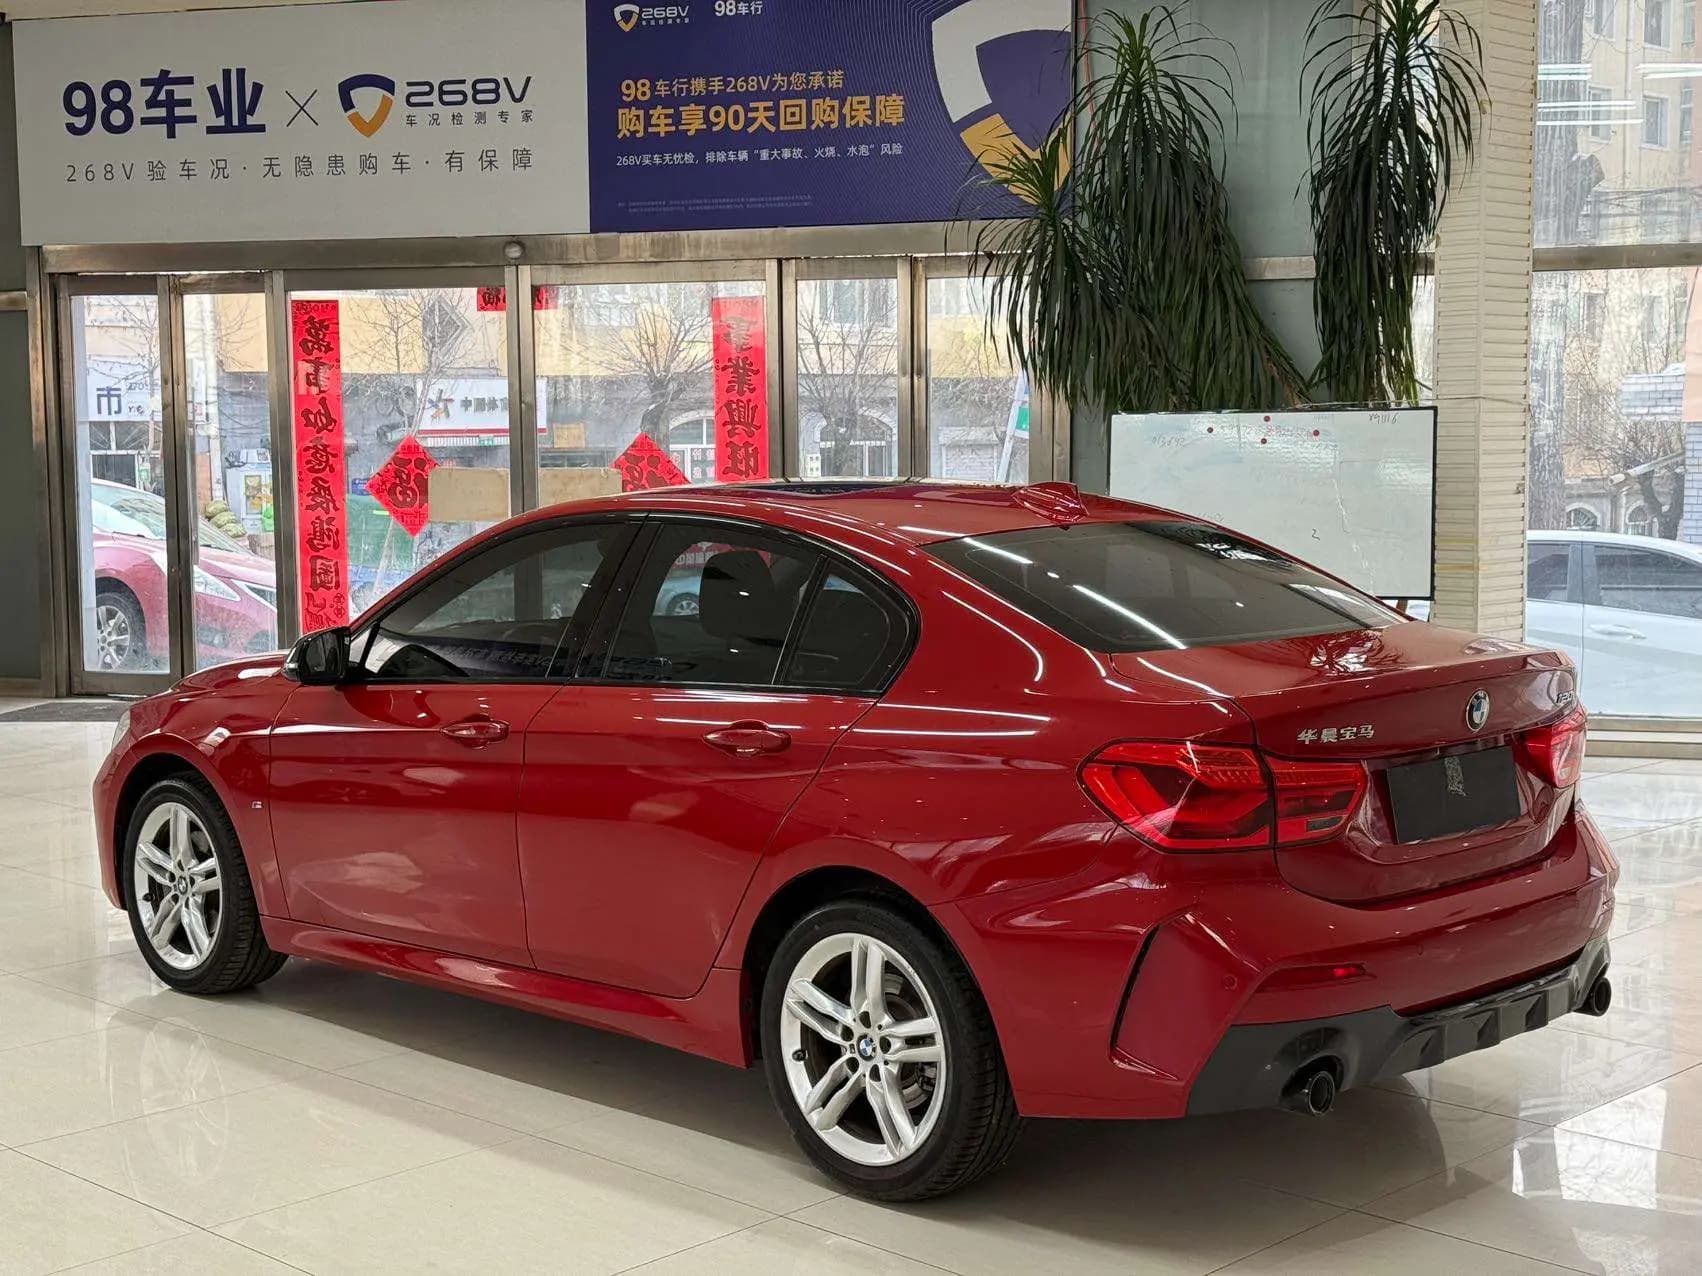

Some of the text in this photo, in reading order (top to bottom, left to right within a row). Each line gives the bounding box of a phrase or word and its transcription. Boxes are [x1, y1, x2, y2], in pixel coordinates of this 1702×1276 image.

[642, 6, 689, 19] 268V
[715, 0, 763, 17] 98车行
[63, 67, 266, 139] 98车业
[404, 76, 532, 107] 268V
[405, 109, 534, 127] 车况检测专家
[617, 93, 905, 139] 购车享90天回购保障
[1297, 724, 1375, 745] 华晨宝马
